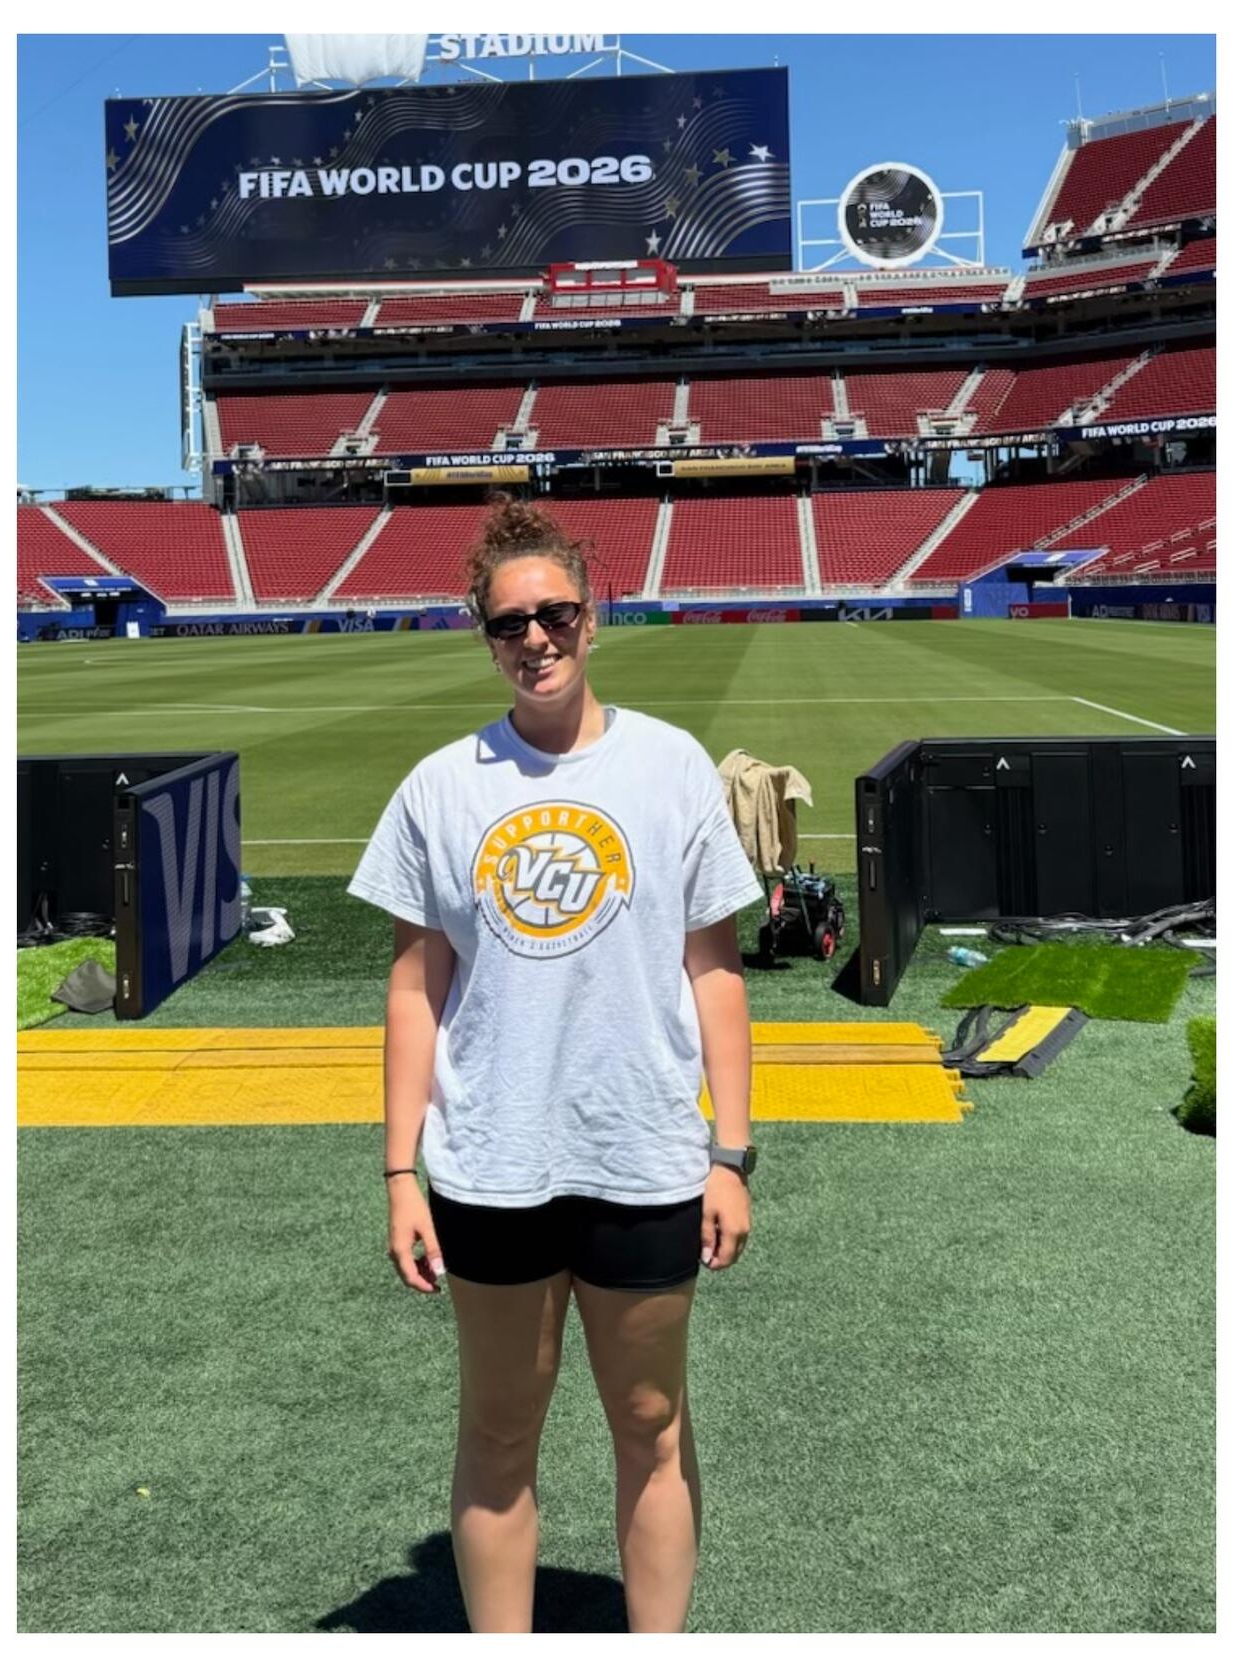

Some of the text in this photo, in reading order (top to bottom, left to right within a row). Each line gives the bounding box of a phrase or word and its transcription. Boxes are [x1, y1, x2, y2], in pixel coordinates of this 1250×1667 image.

[439, 34, 606, 60] STADIUM
[239, 155, 652, 199] FIFA WORLD CUP 2026
[869, 202, 890, 211] FIFA
[869, 210, 904, 218] WORLD
[869, 219, 888, 228] CUP
[1082, 416, 1217, 438] FIFA WORLD CUP 2026
[426, 453, 555, 466] FIFA WORLD CUP 2026
[176, 623, 224, 636] QATAR
[229, 621, 290, 635] AIRWAYS
[338, 618, 375, 632] VISA
[141, 760, 241, 980] VIS
[497, 845, 600, 914] VCU
